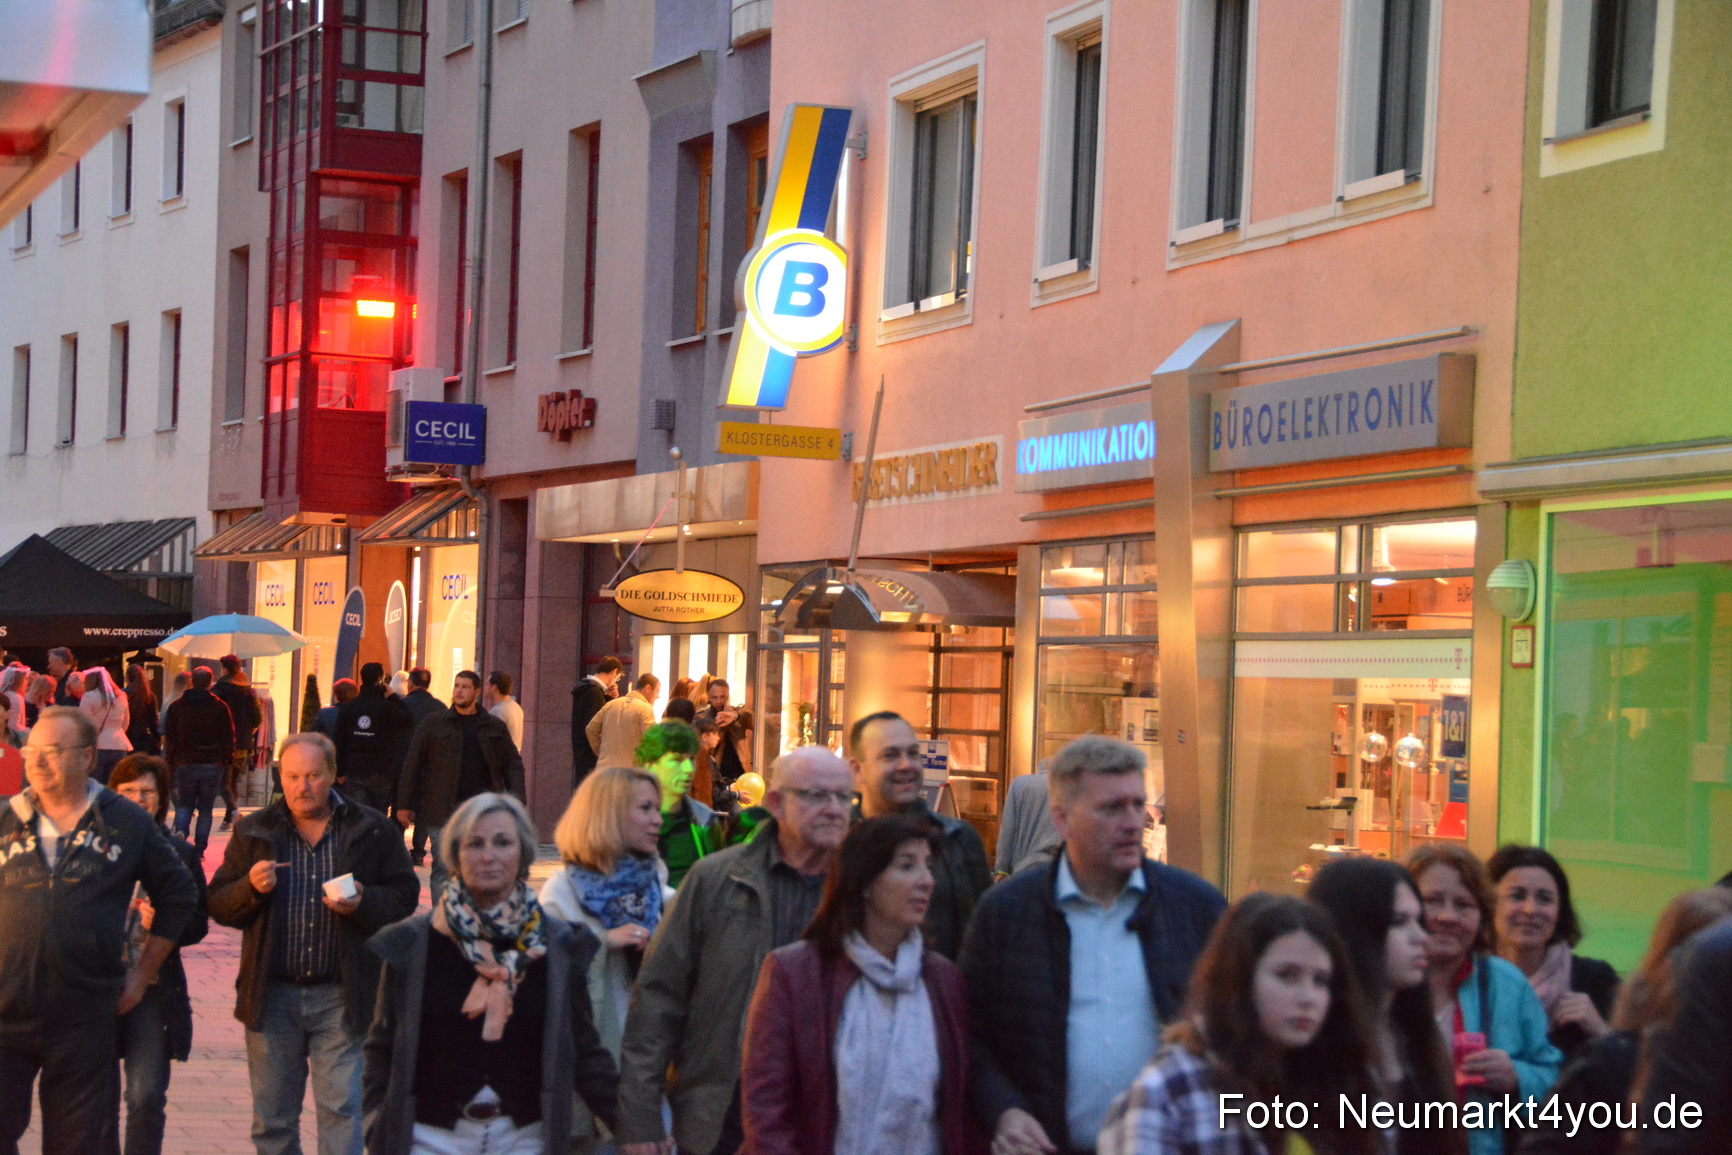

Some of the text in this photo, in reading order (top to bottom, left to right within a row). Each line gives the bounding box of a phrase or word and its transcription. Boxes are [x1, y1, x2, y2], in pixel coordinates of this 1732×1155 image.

[773, 260, 829, 318] B
[1213, 379, 1434, 451] BÜROELEKTRONIK
[415, 420, 476, 440] CECIL
[726, 431, 834, 450] KLOSTERGASSE 4
[265, 584, 286, 607] CECIL
[312, 582, 335, 605] CECIL
[442, 574, 469, 600] CECIL
[620, 589, 739, 604] DIE GOLDSCHMIEDE
[345, 612, 361, 627] CECIL
[676, 606, 705, 614] ROTHER
[1444, 710, 1465, 742] 1&1
